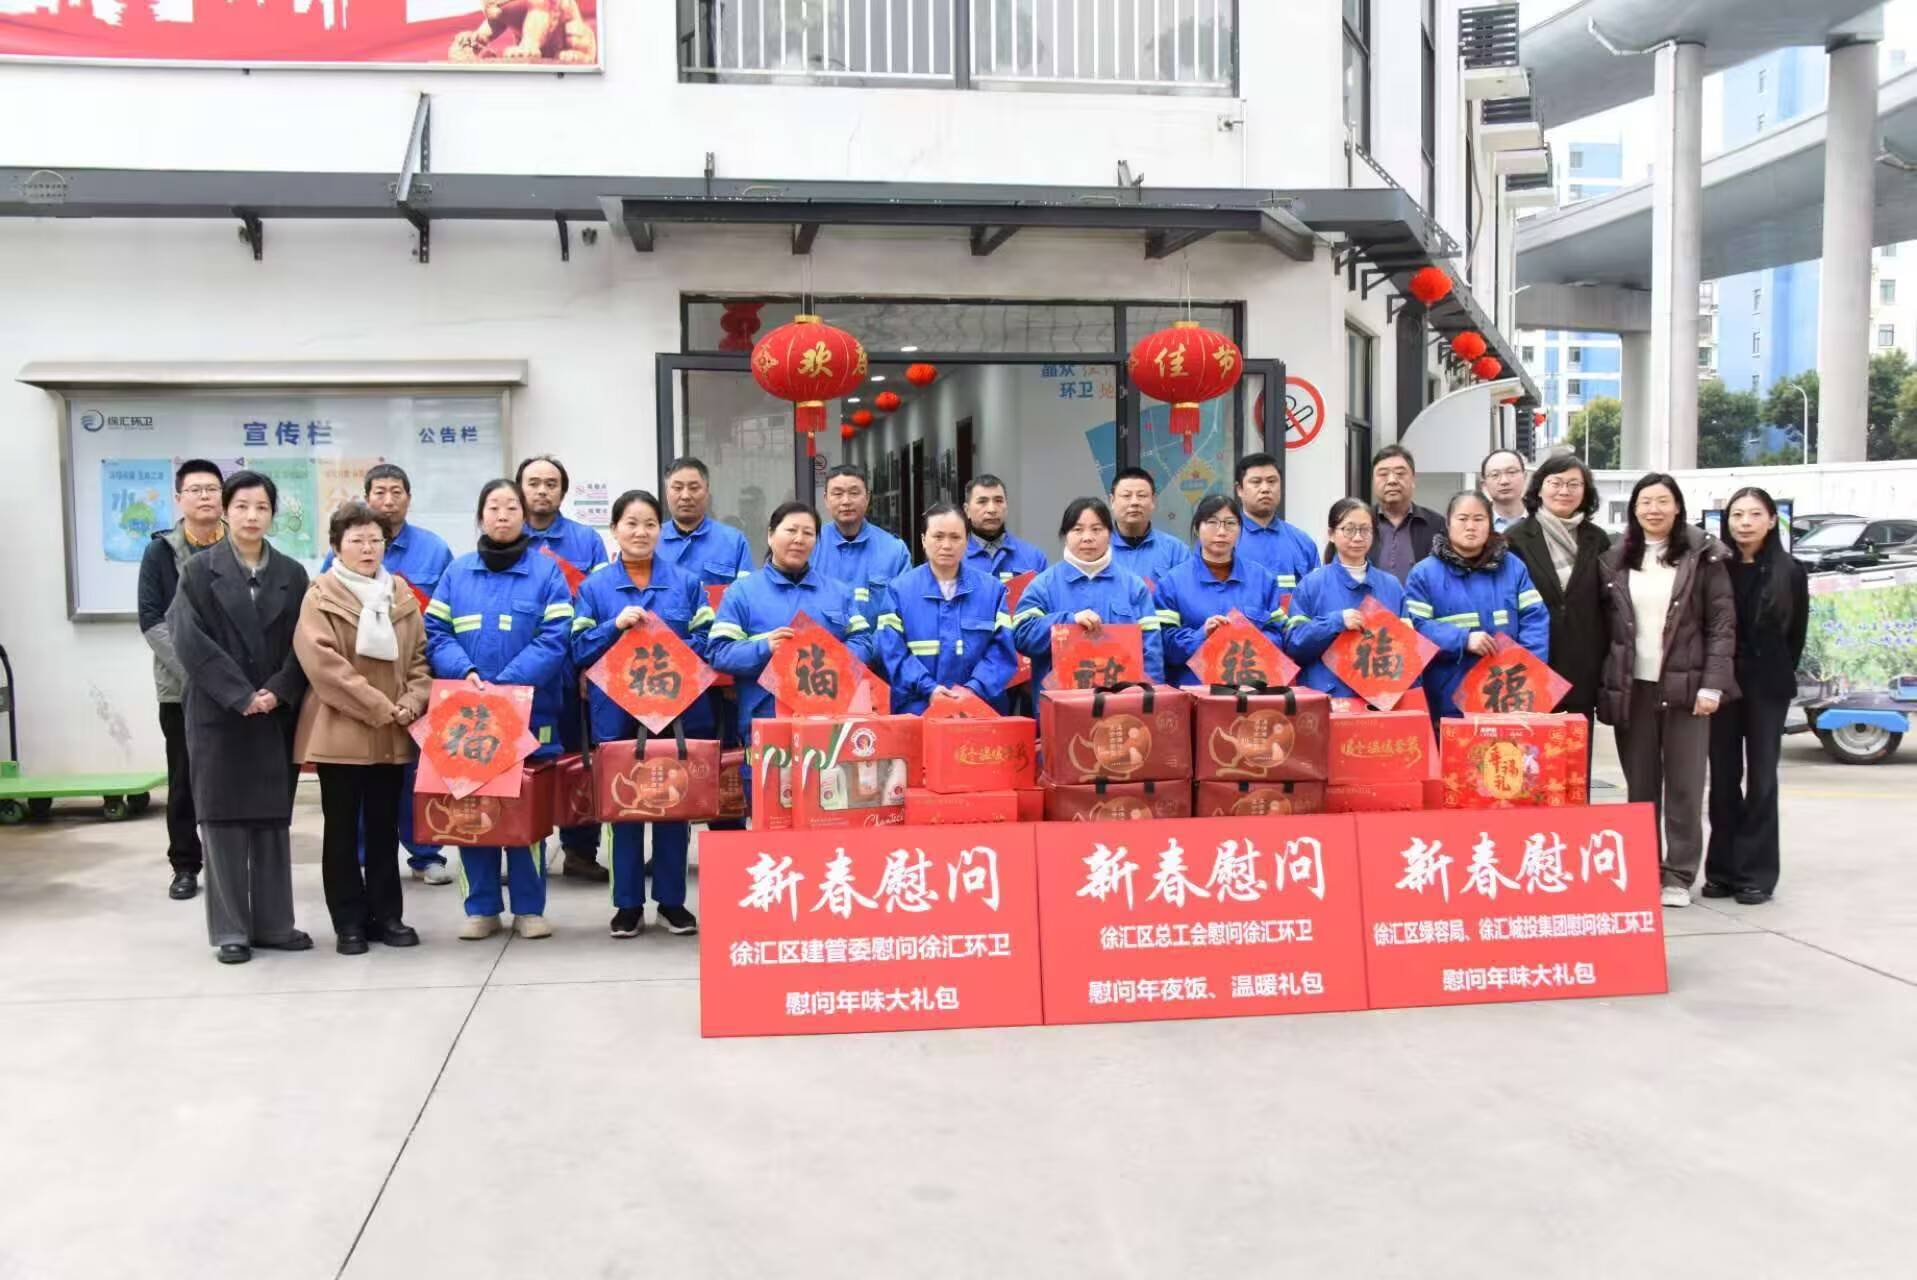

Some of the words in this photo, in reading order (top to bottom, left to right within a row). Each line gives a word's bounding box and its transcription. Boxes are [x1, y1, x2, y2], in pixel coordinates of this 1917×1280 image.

[1154, 344, 1236, 379] 佳节
[243, 421, 332, 446] 宣传栏
[418, 426, 478, 443] 公告栏
[628, 643, 682, 700] 福
[795, 643, 838, 700] 福
[1353, 627, 1402, 680] 福
[1482, 663, 1534, 713] 福
[442, 704, 500, 765] 福
[738, 846, 999, 922] 新春慰问
[1075, 837, 1326, 910] 新春慰问
[1395, 829, 1628, 904] 新春慰问
[729, 933, 1011, 966] 徐汇区建管委慰问徐汇环卫
[1100, 919, 1313, 950] 徐汇区总工会慰问徐汇环卫
[1088, 972, 1324, 1004] 慰问年夜饭、温暖礼包
[1442, 962, 1596, 992] 慰问年味大礼包
[785, 986, 960, 1016] 慰问年味大礼包
